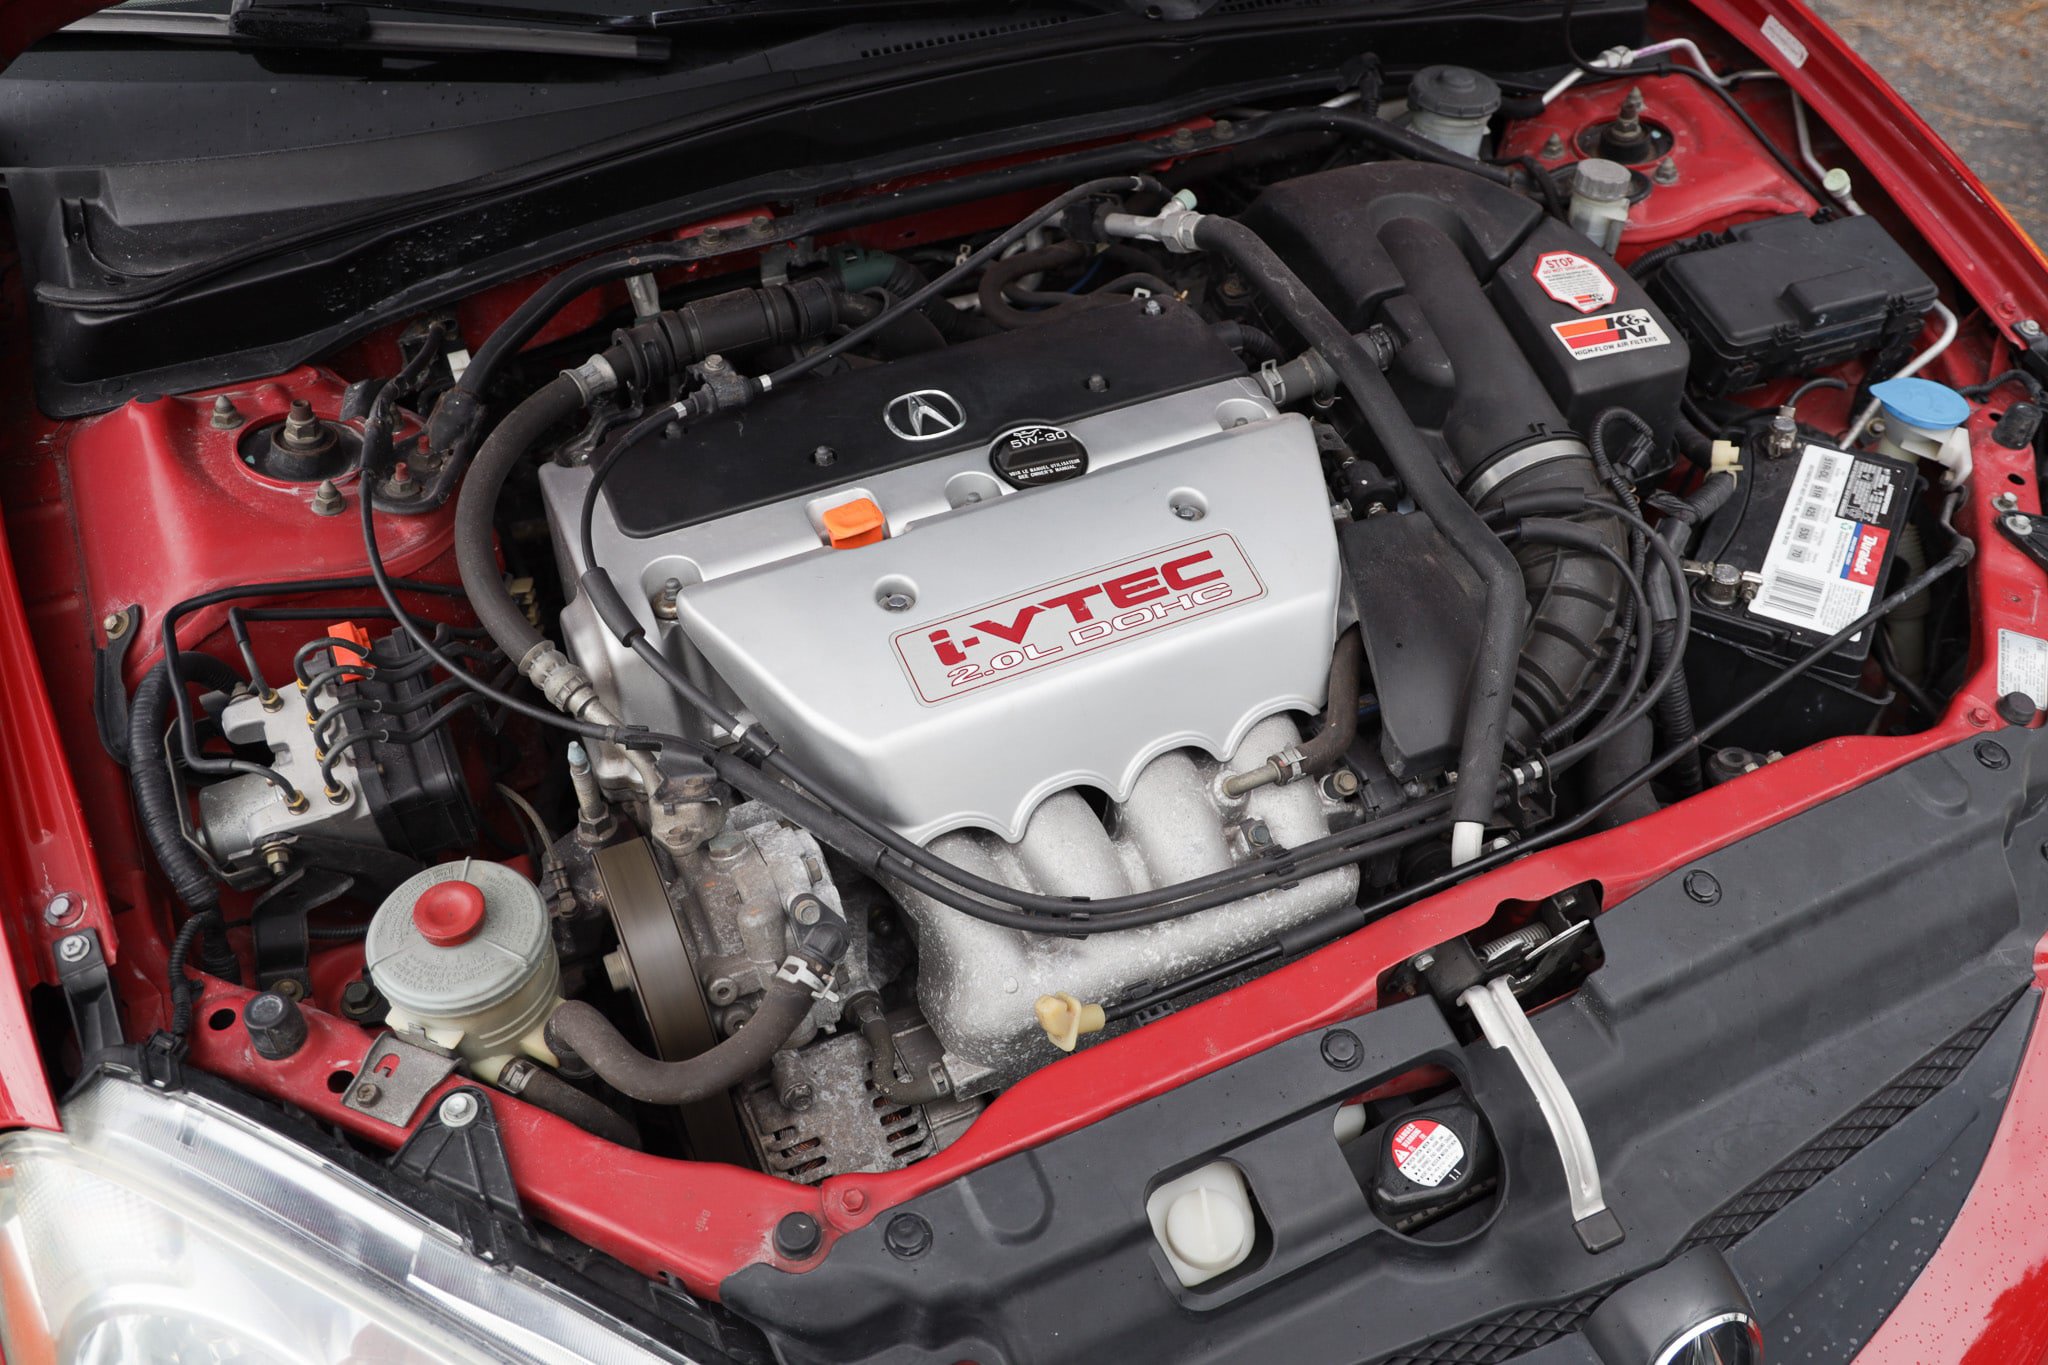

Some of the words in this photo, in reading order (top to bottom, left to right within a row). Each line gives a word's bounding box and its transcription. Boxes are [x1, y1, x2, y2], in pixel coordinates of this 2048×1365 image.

[1545, 257, 1574, 269] STOP
[1606, 313, 1651, 340] K&N
[1574, 344, 1615, 356] HIGH-FLOW
[1617, 340, 1629, 348] AIR
[1630, 336, 1658, 345] FILTERS
[1010, 431, 1067, 448] 5W-30
[1812, 485, 1824, 498] 51R
[1853, 535, 1878, 575] Duralast
[928, 551, 1224, 666] i-VTEC
[947, 643, 1063, 687] 2.0L
[1068, 583, 1233, 645] DOHC
[1448, 1168, 1462, 1181] 1.1
